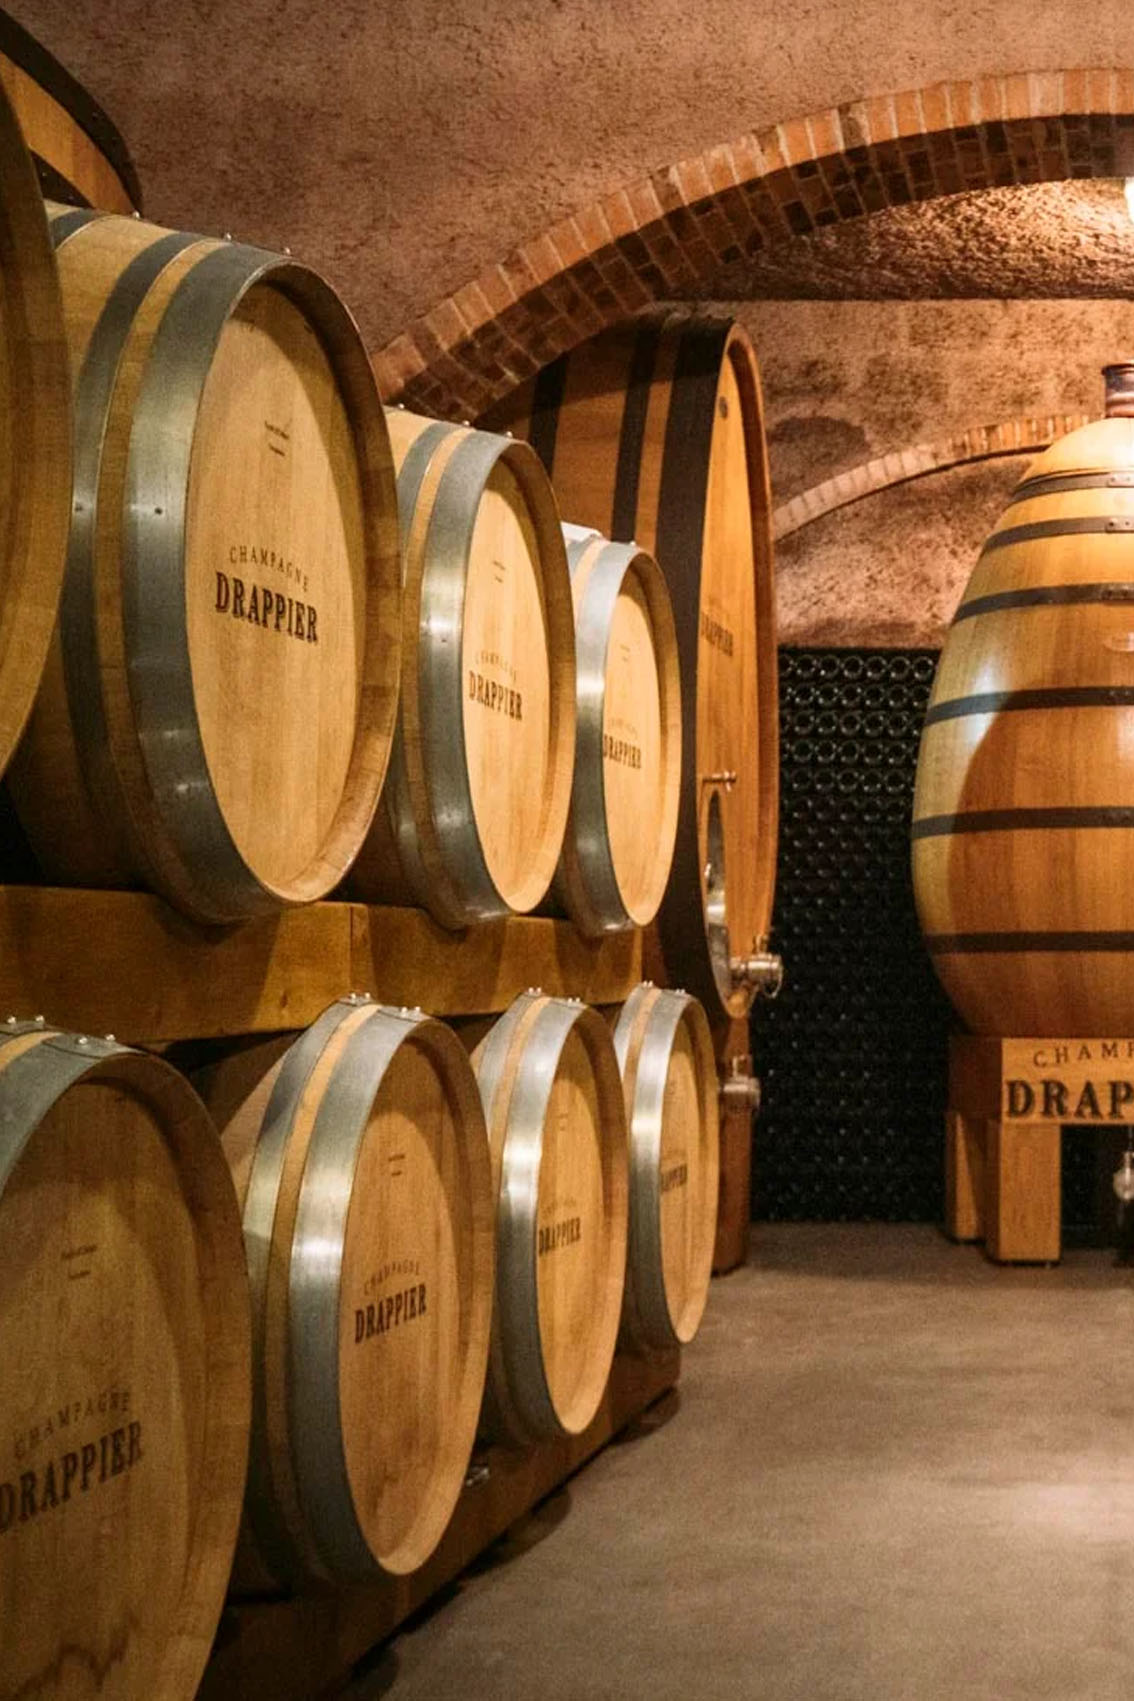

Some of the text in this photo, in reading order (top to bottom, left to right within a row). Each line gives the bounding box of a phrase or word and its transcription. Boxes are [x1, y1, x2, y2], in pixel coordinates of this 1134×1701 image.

[229, 546, 309, 592] CHAMPAGNE
[215, 571, 318, 643] DRAPPIER
[469, 670, 522, 720] DRAPPIER
[355, 1284, 427, 1344] DRAPPIER
[0, 1421, 143, 1535] DRAPPIER
